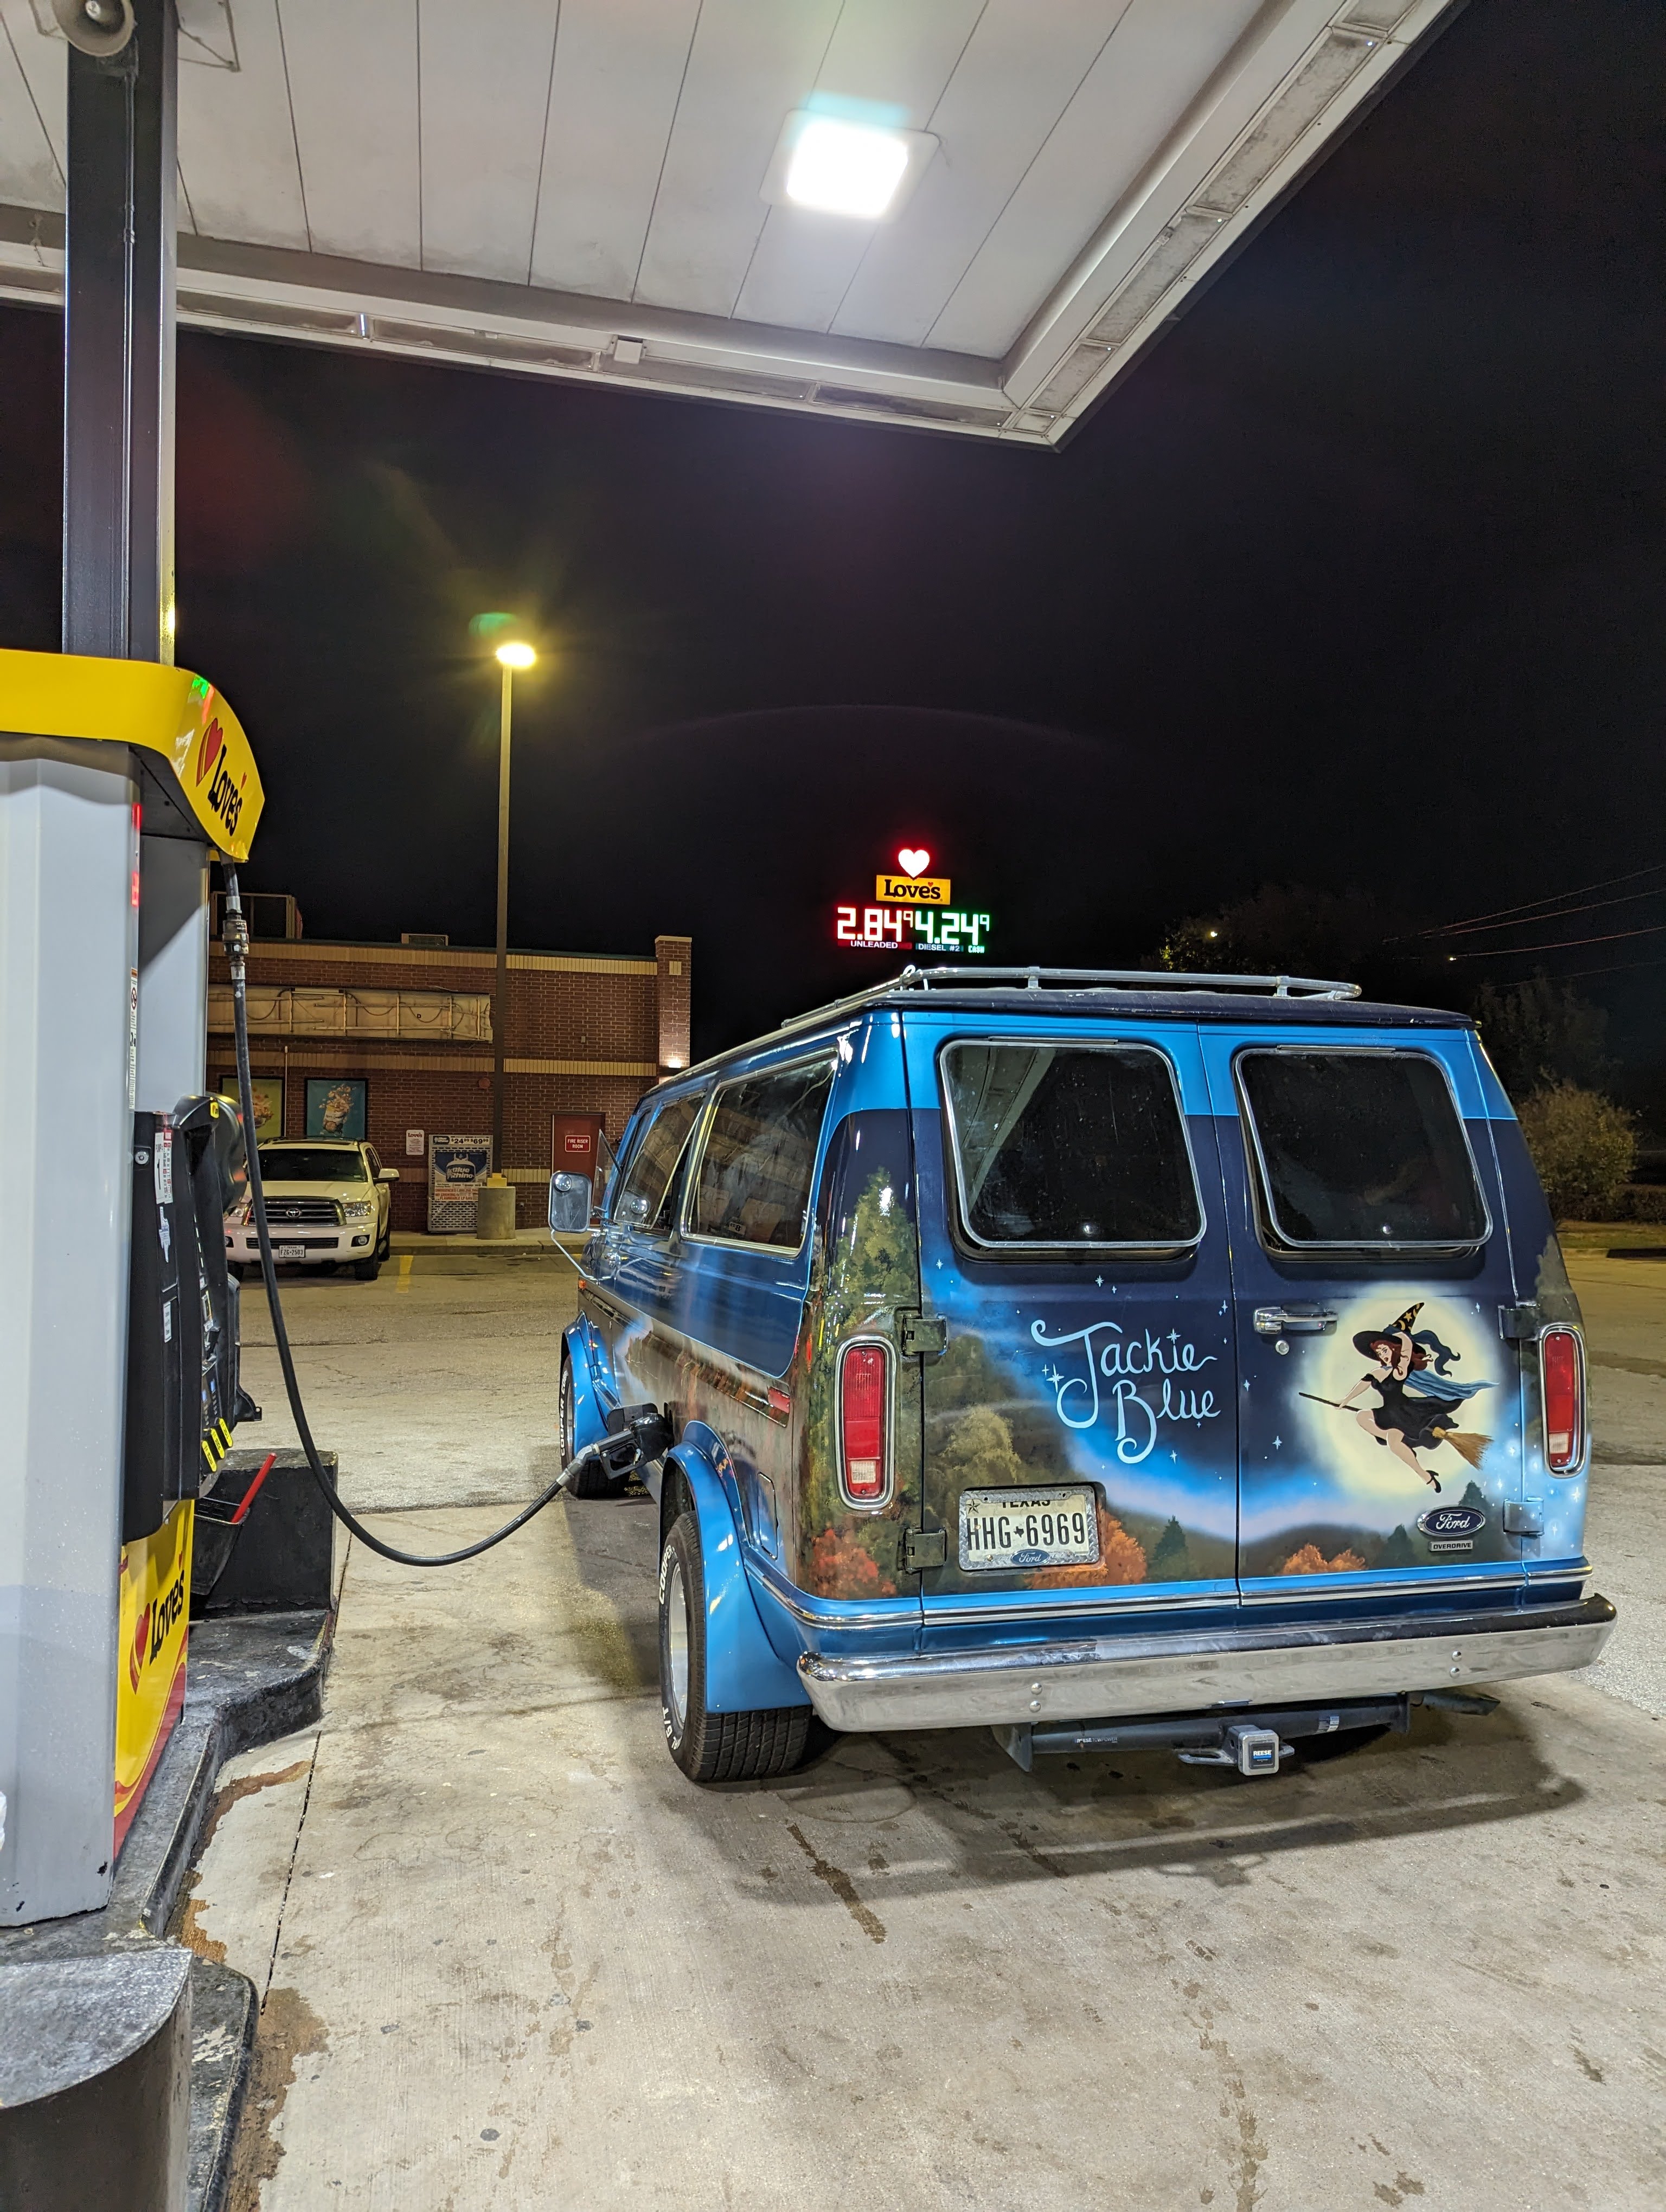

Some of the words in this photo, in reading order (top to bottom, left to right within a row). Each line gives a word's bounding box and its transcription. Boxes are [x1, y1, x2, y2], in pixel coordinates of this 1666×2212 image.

[850, 940, 898, 949] UNLEADED
[918, 943, 946, 951] DIESEL
[1030, 1320, 1218, 1429] Jackie
[1112, 1378, 1221, 1464] Blue
[1436, 1513, 1471, 1530] Ford
[1433, 1542, 1472, 1550] OVERDRIVE
[1018, 1552, 1042, 1563] Ford
[659, 1545, 674, 1605] COOPER
